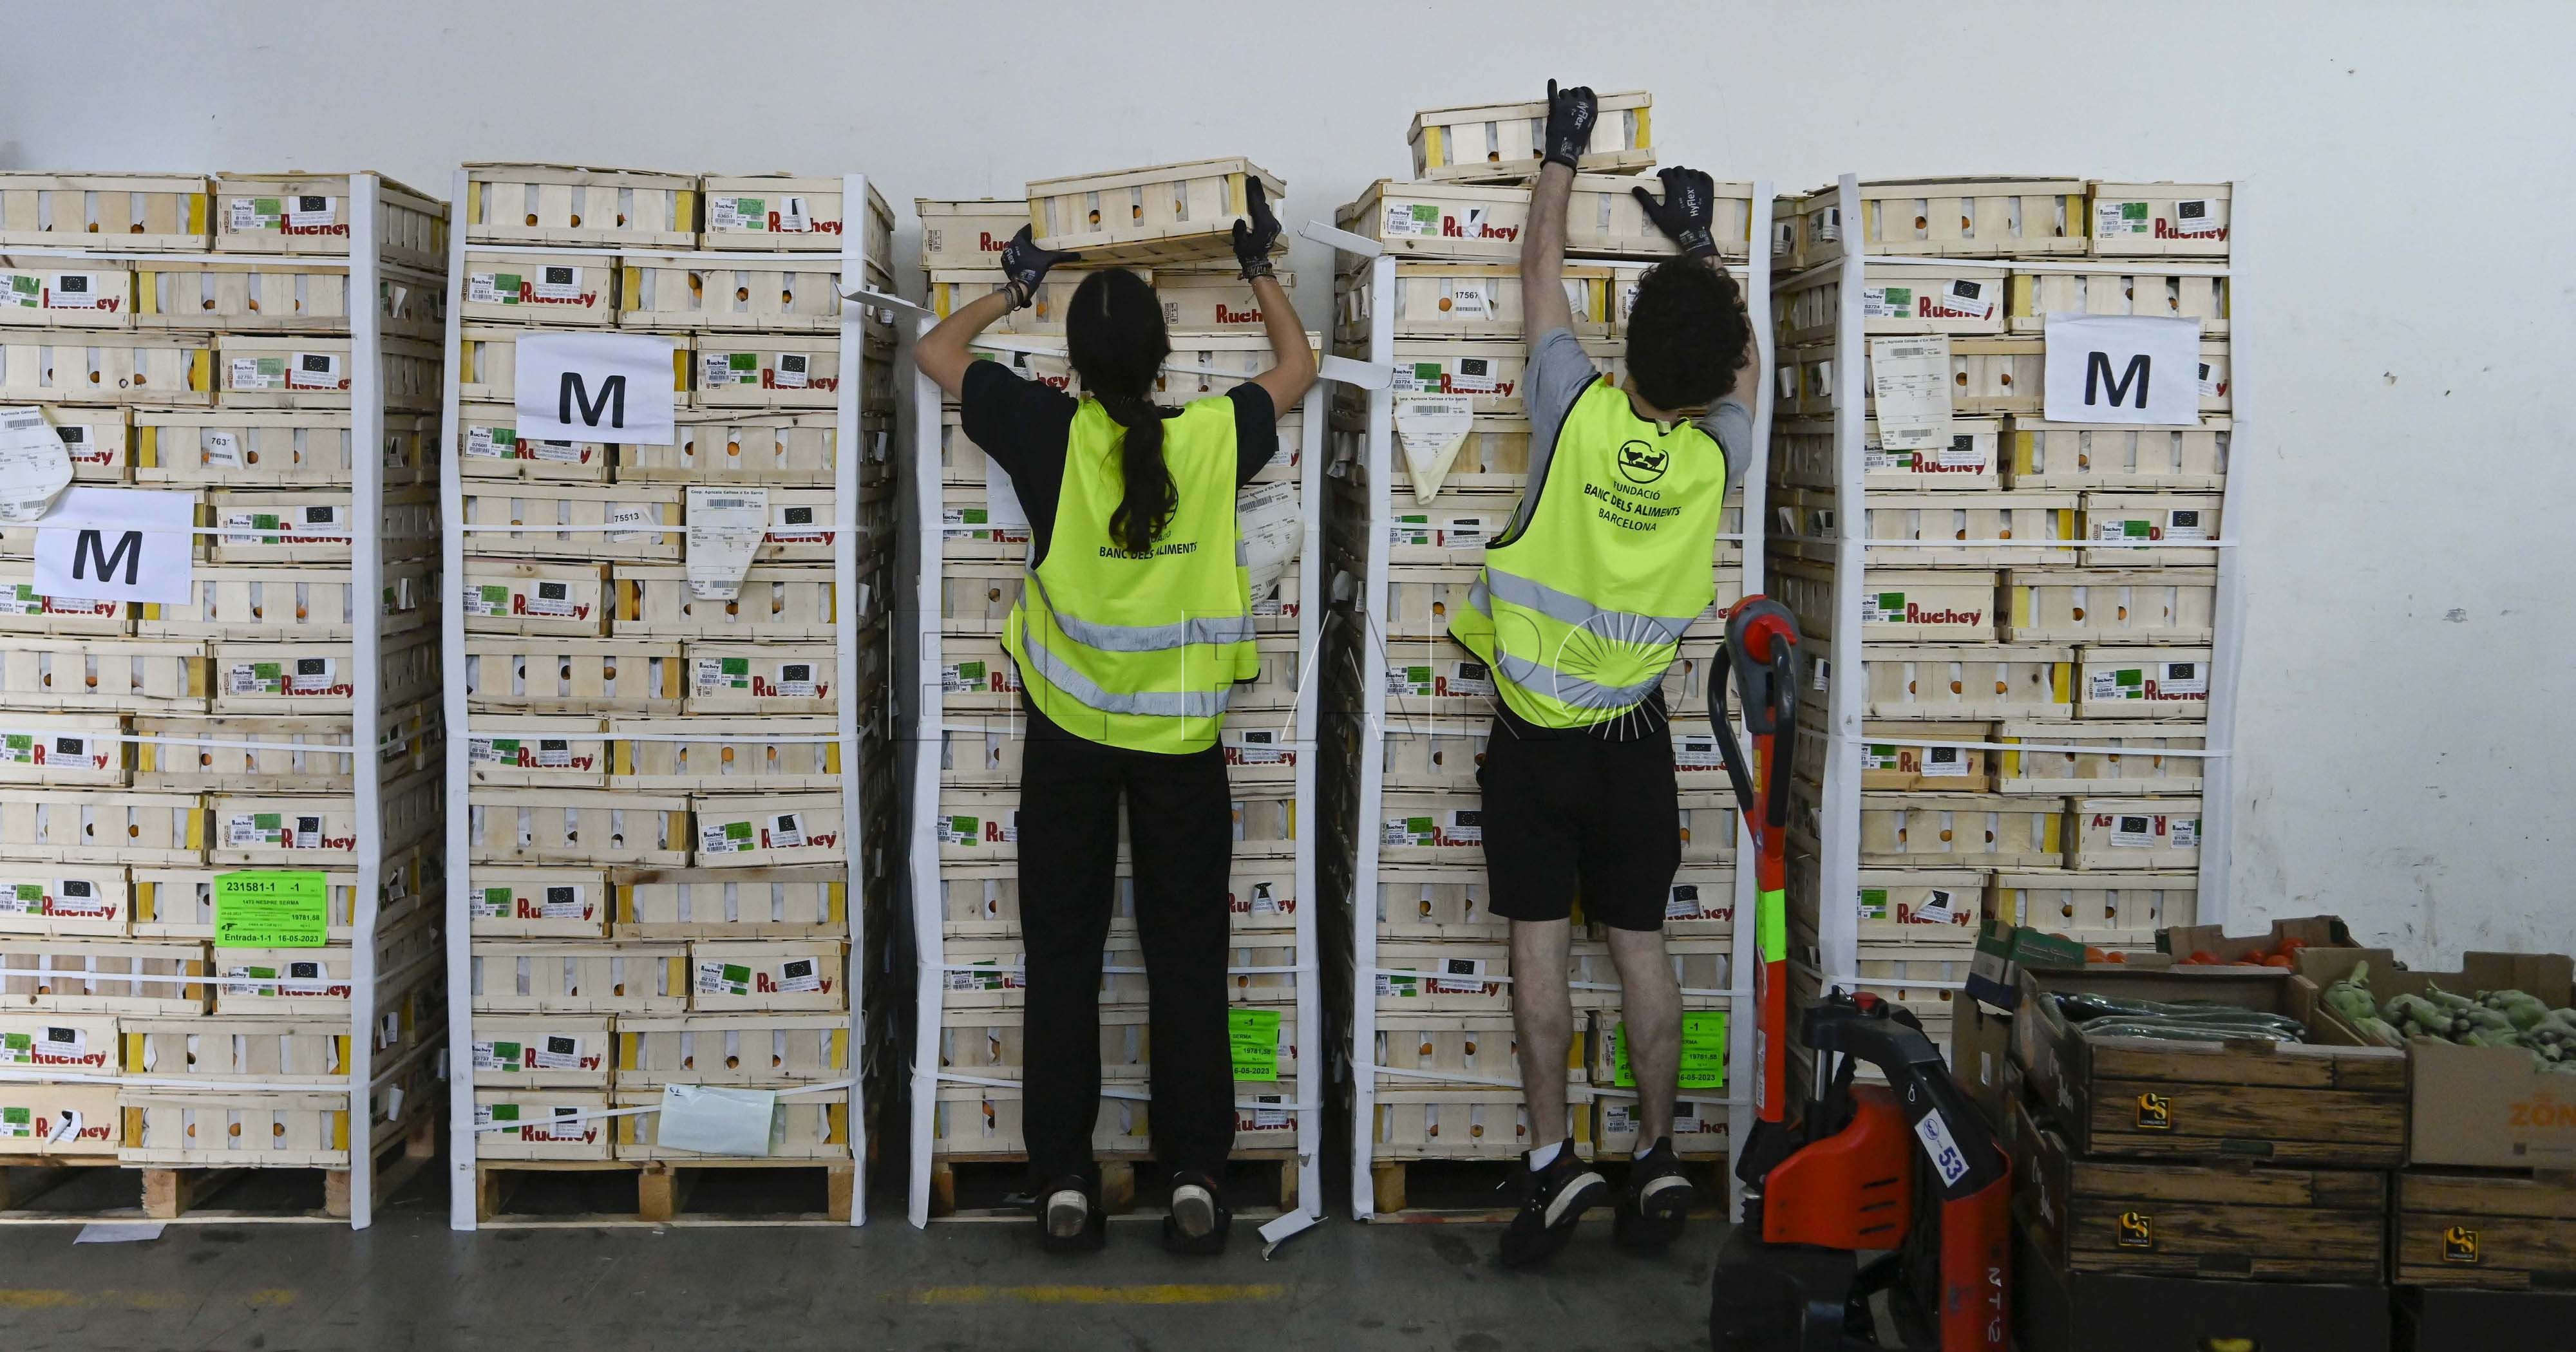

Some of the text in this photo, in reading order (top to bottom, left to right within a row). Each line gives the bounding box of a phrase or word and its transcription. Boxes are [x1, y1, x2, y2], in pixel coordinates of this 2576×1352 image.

[1575, 101, 1589, 129] HyFlex
[715, 202, 735, 210] Ruchey
[1687, 189, 1699, 218] HyFlex
[768, 211, 843, 235] Rhey
[1443, 216, 1519, 242] Rhey
[980, 232, 1009, 252] Ruc
[1005, 247, 1016, 265] Flex
[1216, 304, 1264, 323] Ruch
[1919, 296, 1994, 321] Rucy
[762, 368, 839, 392] Rhey
[1036, 371, 1070, 391] hey
[2084, 351, 2150, 409] M
[559, 371, 626, 428] M
[211, 437, 231, 446] 763
[469, 430, 490, 438] Ruchey
[515, 438, 591, 464] Ruy
[1584, 483, 1681, 518] BANC DELS ALIMENTS
[1613, 481, 1660, 501] FUNDACIÓ
[614, 512, 639, 522] 75513
[1598, 508, 1657, 531] BARCELONA
[73, 529, 142, 585] M
[1099, 547, 1127, 559] BANC
[1155, 541, 1197, 556] ALIMENTS
[41, 596, 117, 618] Rey
[1907, 603, 1981, 626] Ruchey
[753, 675, 828, 699] Ruy
[517, 747, 593, 771] Ruey
[2092, 813, 2166, 836] Rey
[281, 828, 357, 852] Rhey
[761, 828, 837, 849] Rhey
[227, 882, 299, 892] 231581-1 -1
[517, 897, 594, 921] Ruy
[1897, 903, 1971, 927] Ruey
[225, 934, 272, 942] Entrada-1-1
[701, 965, 720, 974] Ruchey
[757, 973, 832, 994] Ruy
[1689, 1022, 1700, 1031] -1
[525, 1047, 600, 1071] Rey
[36, 1117, 110, 1141] Rhey
[1939, 1146, 1963, 1179] 53
